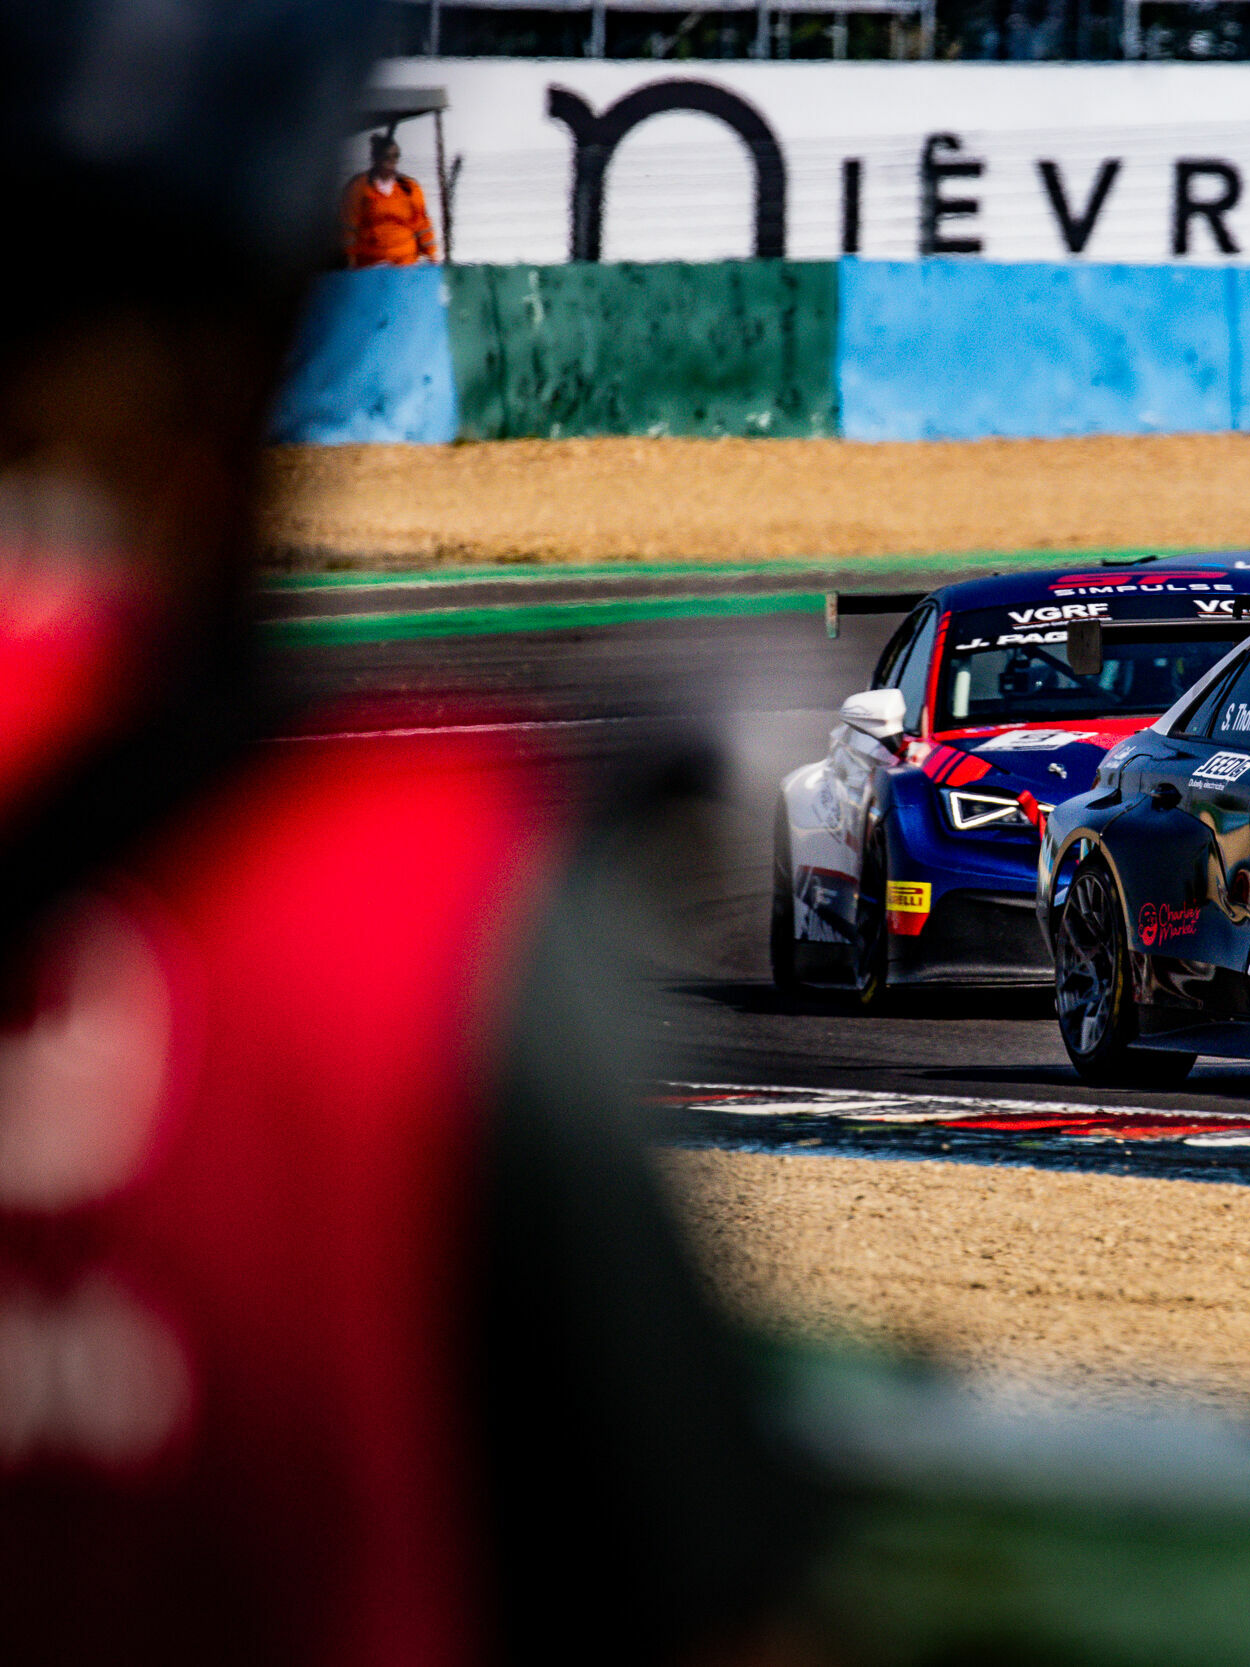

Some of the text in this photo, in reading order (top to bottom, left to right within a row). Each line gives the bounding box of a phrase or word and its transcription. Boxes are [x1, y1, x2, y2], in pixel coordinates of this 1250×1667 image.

[1053, 583, 1235, 597] SIMPULSE
[1007, 603, 1109, 624] VGRF
[955, 630, 1069, 650] J. PAG
[1221, 702, 1236, 732] S.
